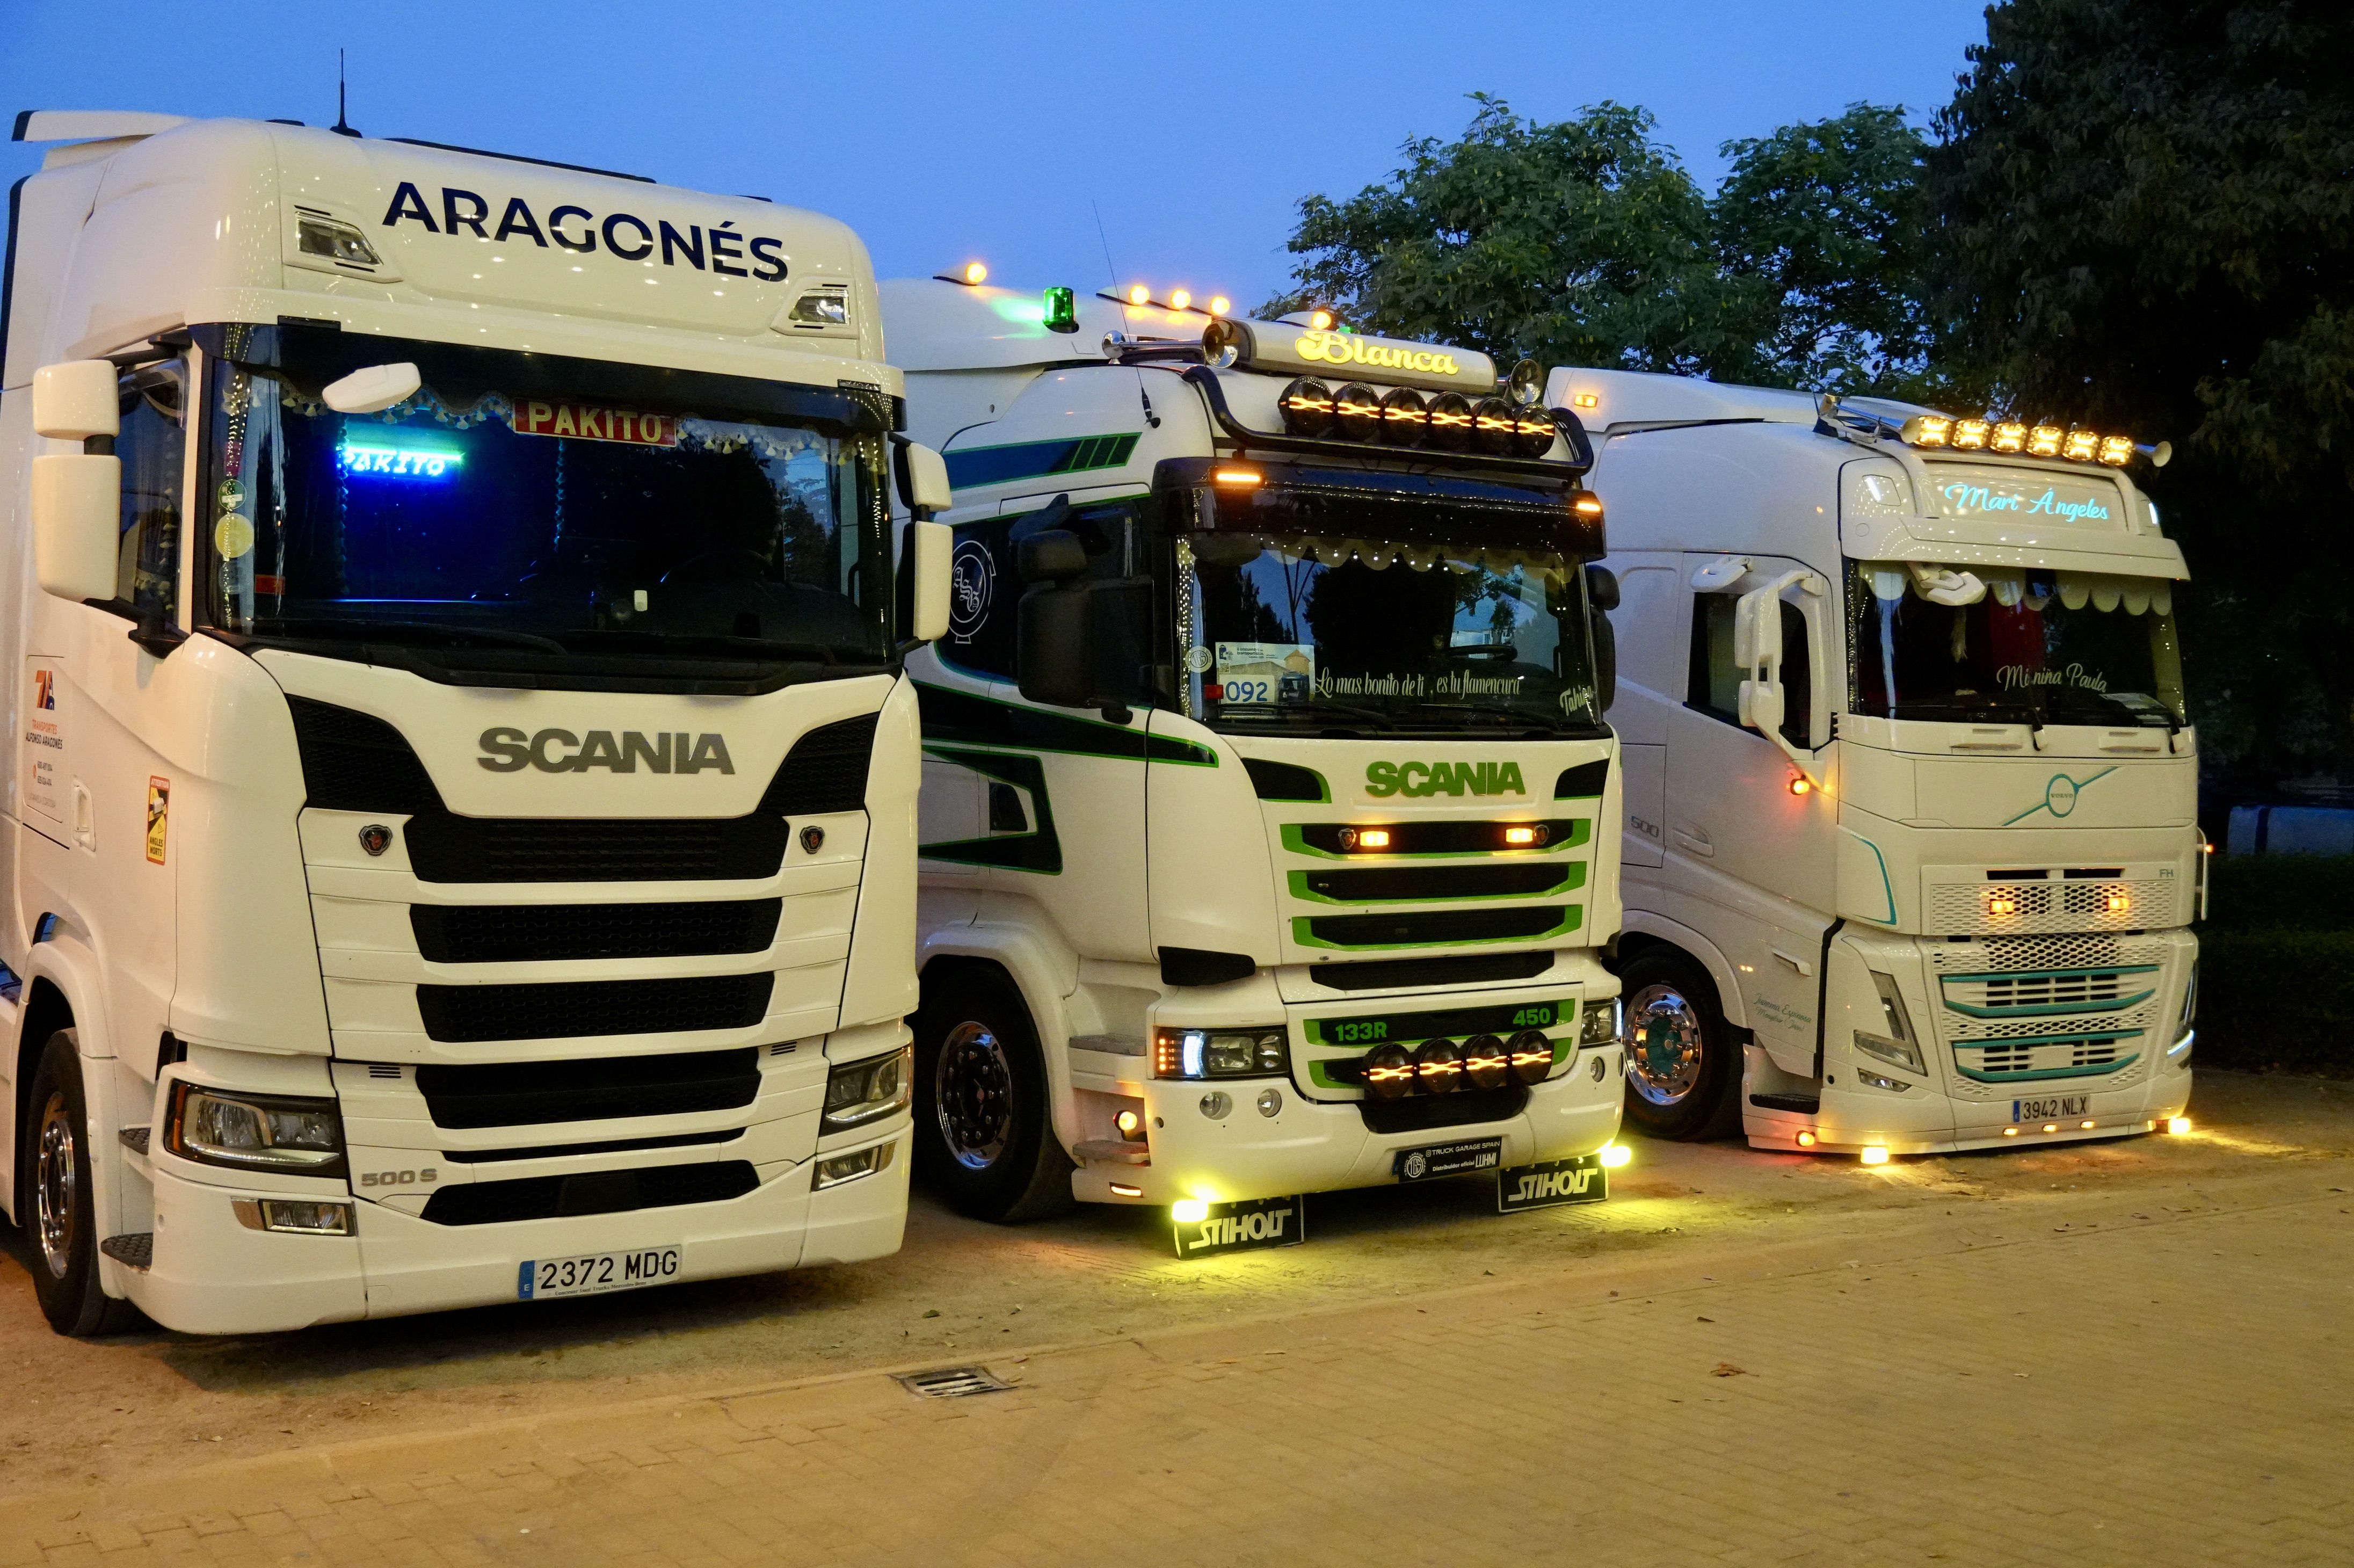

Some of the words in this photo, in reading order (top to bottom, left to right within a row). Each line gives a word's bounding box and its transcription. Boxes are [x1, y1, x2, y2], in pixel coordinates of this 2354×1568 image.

[382, 182, 788, 282] ARAGONÉS
[1295, 330, 1459, 375] Blanca
[528, 402, 662, 443] PAKITO
[344, 452, 445, 476] PAKITO
[1944, 484, 2018, 511] Mari
[1315, 667, 1333, 698] Lo
[1336, 677, 1362, 694] mas
[1364, 671, 1399, 696] bonito
[1402, 673, 1415, 696] de
[1437, 677, 1448, 693] es
[1450, 671, 1461, 694] tu
[1460, 669, 1520, 700] flamencura
[1996, 665, 2029, 692] Mi
[2066, 663, 2106, 693] Paula
[1226, 681, 1268, 702] 092
[26, 732, 41, 745] ALFONSO
[477, 727, 735, 774] SCANIA
[1365, 761, 1526, 797] SCANIA
[1631, 816, 1659, 838] 500
[149, 836, 163, 847] ANGLES
[150, 846, 162, 856] MORTS
[2160, 869, 2174, 877] FH
[1513, 1007, 1550, 1026] 450
[1335, 1021, 1387, 1042] 133R
[2023, 1100, 2058, 1119] 3942
[2062, 1097, 2087, 1116] NLX
[1432, 1147, 1454, 1155] TRUCK
[1455, 1144, 1481, 1152] GARAGE
[1476, 1152, 1496, 1168] LUHMI
[361, 1170, 416, 1186] 500
[420, 1168, 437, 1182] S
[1508, 1168, 1598, 1202] STIHOLT
[1189, 1208, 1292, 1250] STIHOLT
[541, 1257, 614, 1289] 2372
[625, 1251, 677, 1280] MDG
